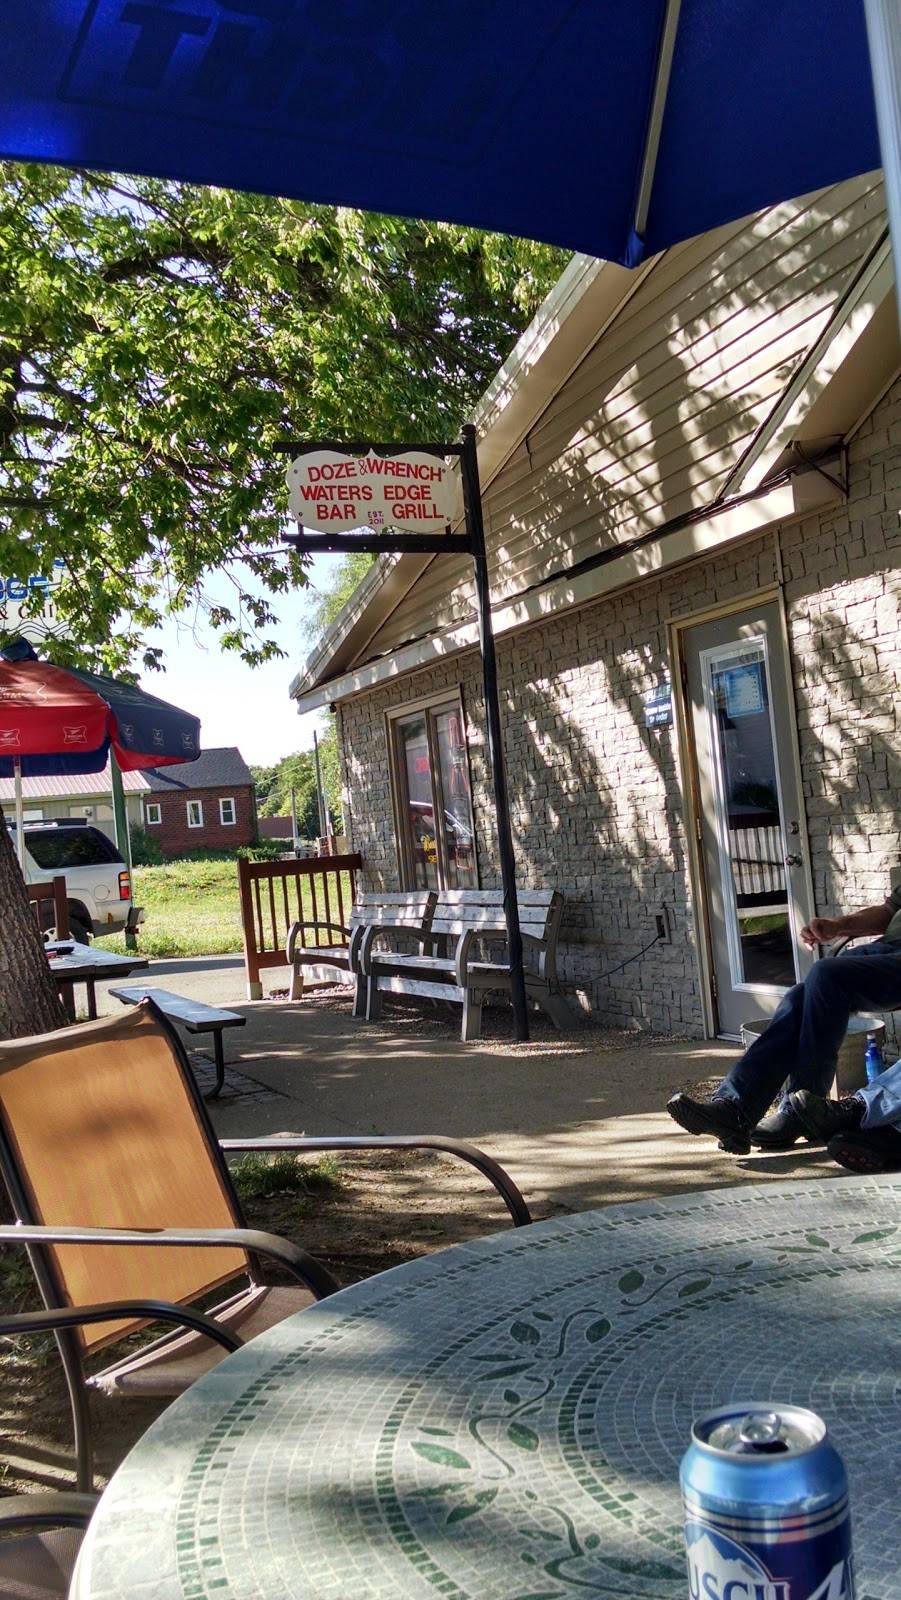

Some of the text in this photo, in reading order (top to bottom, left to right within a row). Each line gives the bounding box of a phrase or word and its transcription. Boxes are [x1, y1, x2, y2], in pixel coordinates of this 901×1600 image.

[308, 462, 357, 482] DOZE
[366, 458, 442, 481] WRENCH
[301, 485, 432, 501] WATERS EDGE
[317, 503, 444, 520] BAR GRILL
